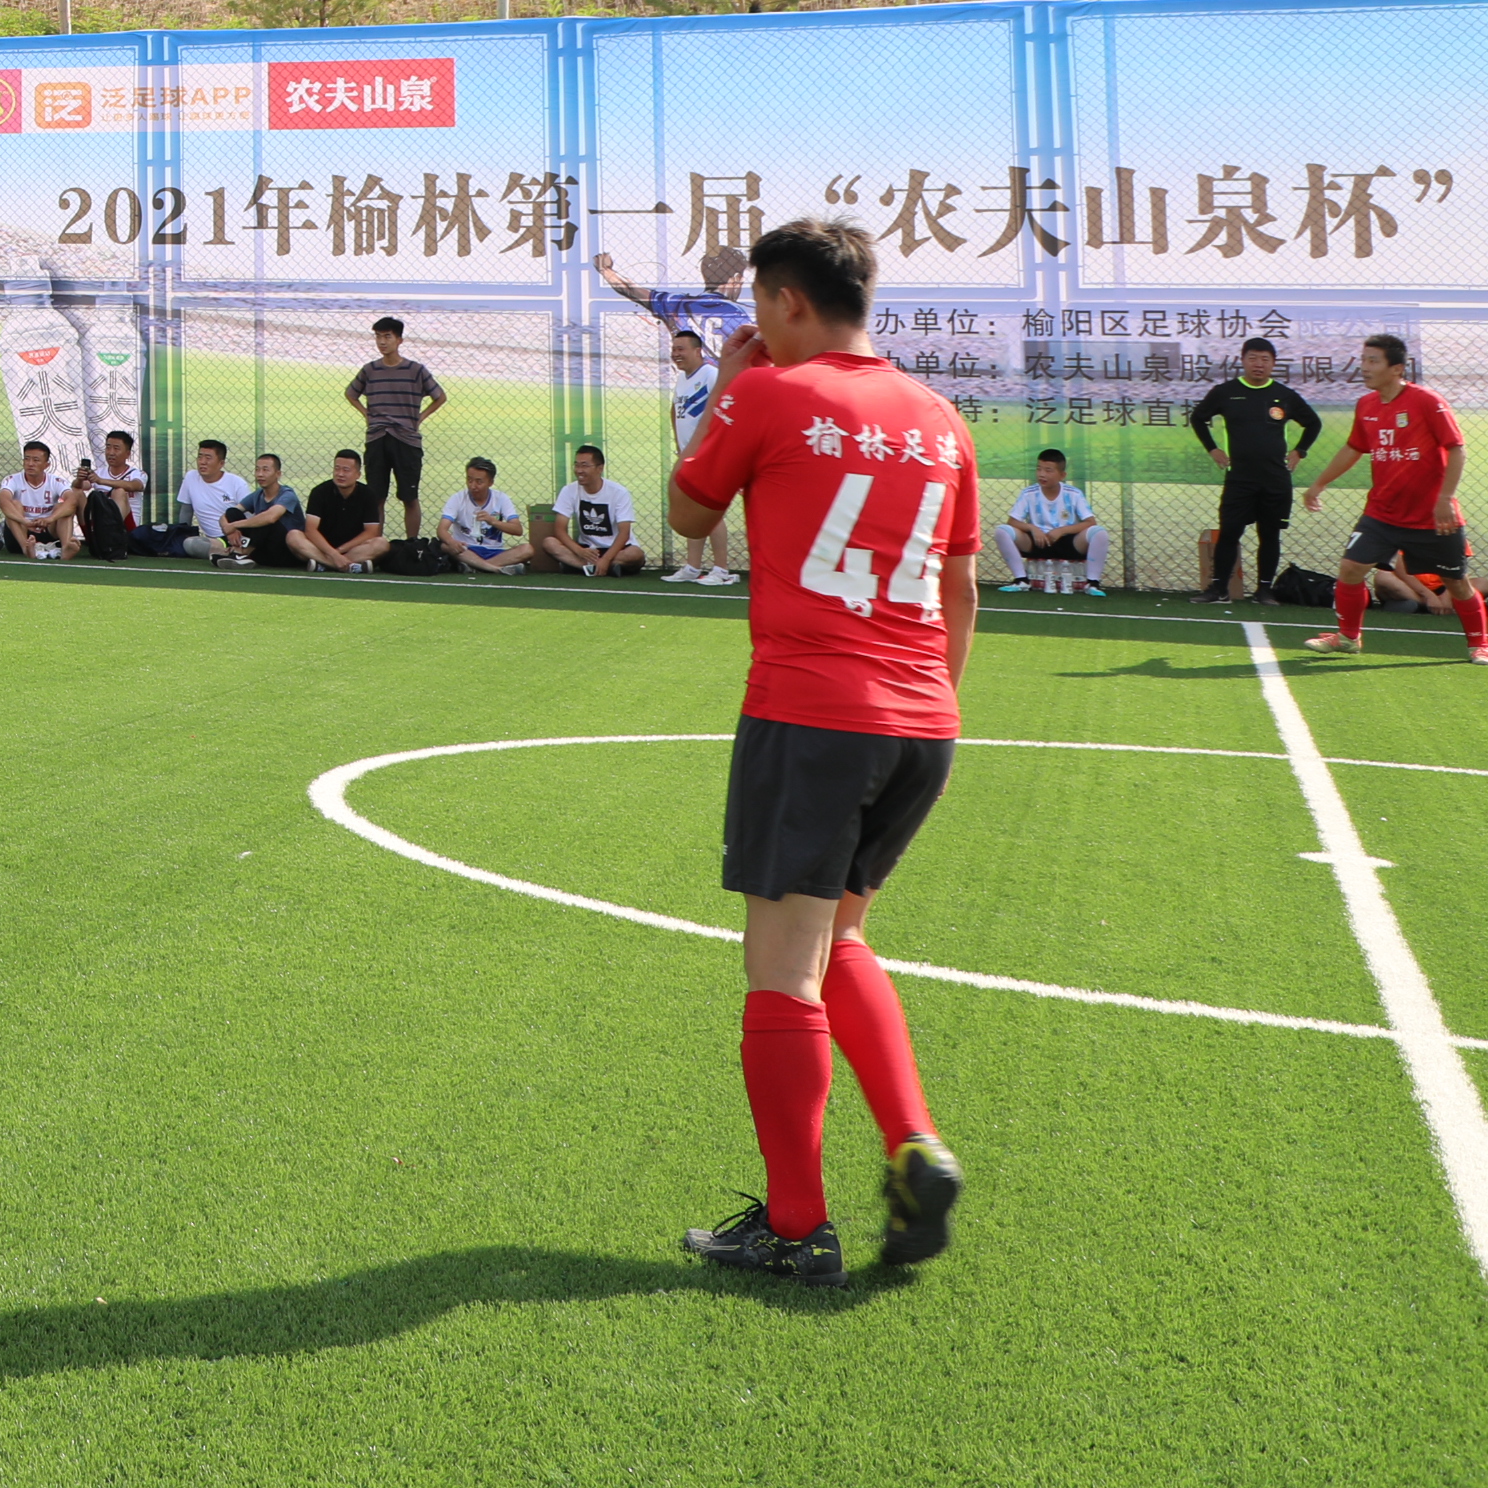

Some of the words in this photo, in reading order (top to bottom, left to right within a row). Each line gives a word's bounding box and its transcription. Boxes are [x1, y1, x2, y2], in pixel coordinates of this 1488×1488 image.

[100, 86, 252, 109] 泛足球APP
[285, 75, 435, 113] 农夫山泉
[1378, 429, 1395, 445] 57
[800, 473, 947, 620] 44
